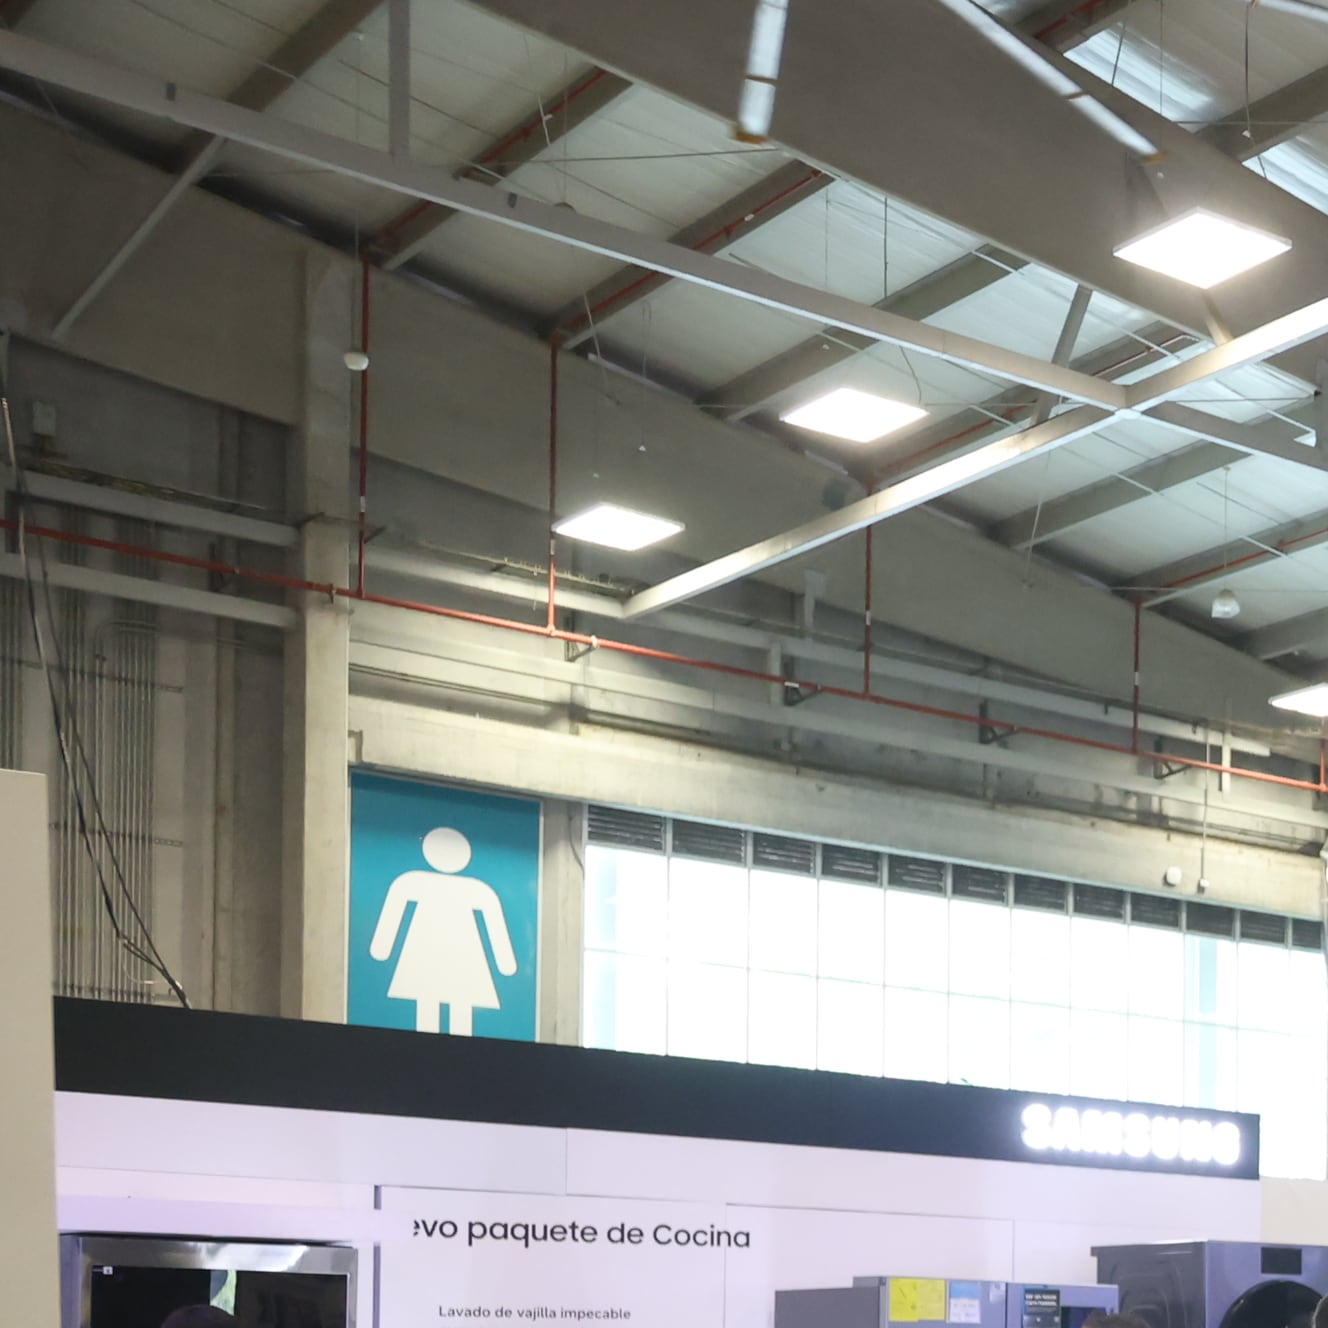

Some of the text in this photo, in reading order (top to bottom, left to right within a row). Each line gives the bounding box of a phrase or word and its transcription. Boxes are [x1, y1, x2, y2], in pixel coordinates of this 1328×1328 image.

[1021, 1103, 1240, 1166] SAMSUNG
[467, 1219, 751, 1249] paquete de Cocina
[438, 1305, 631, 1321] Lavado de vajilla impecable
